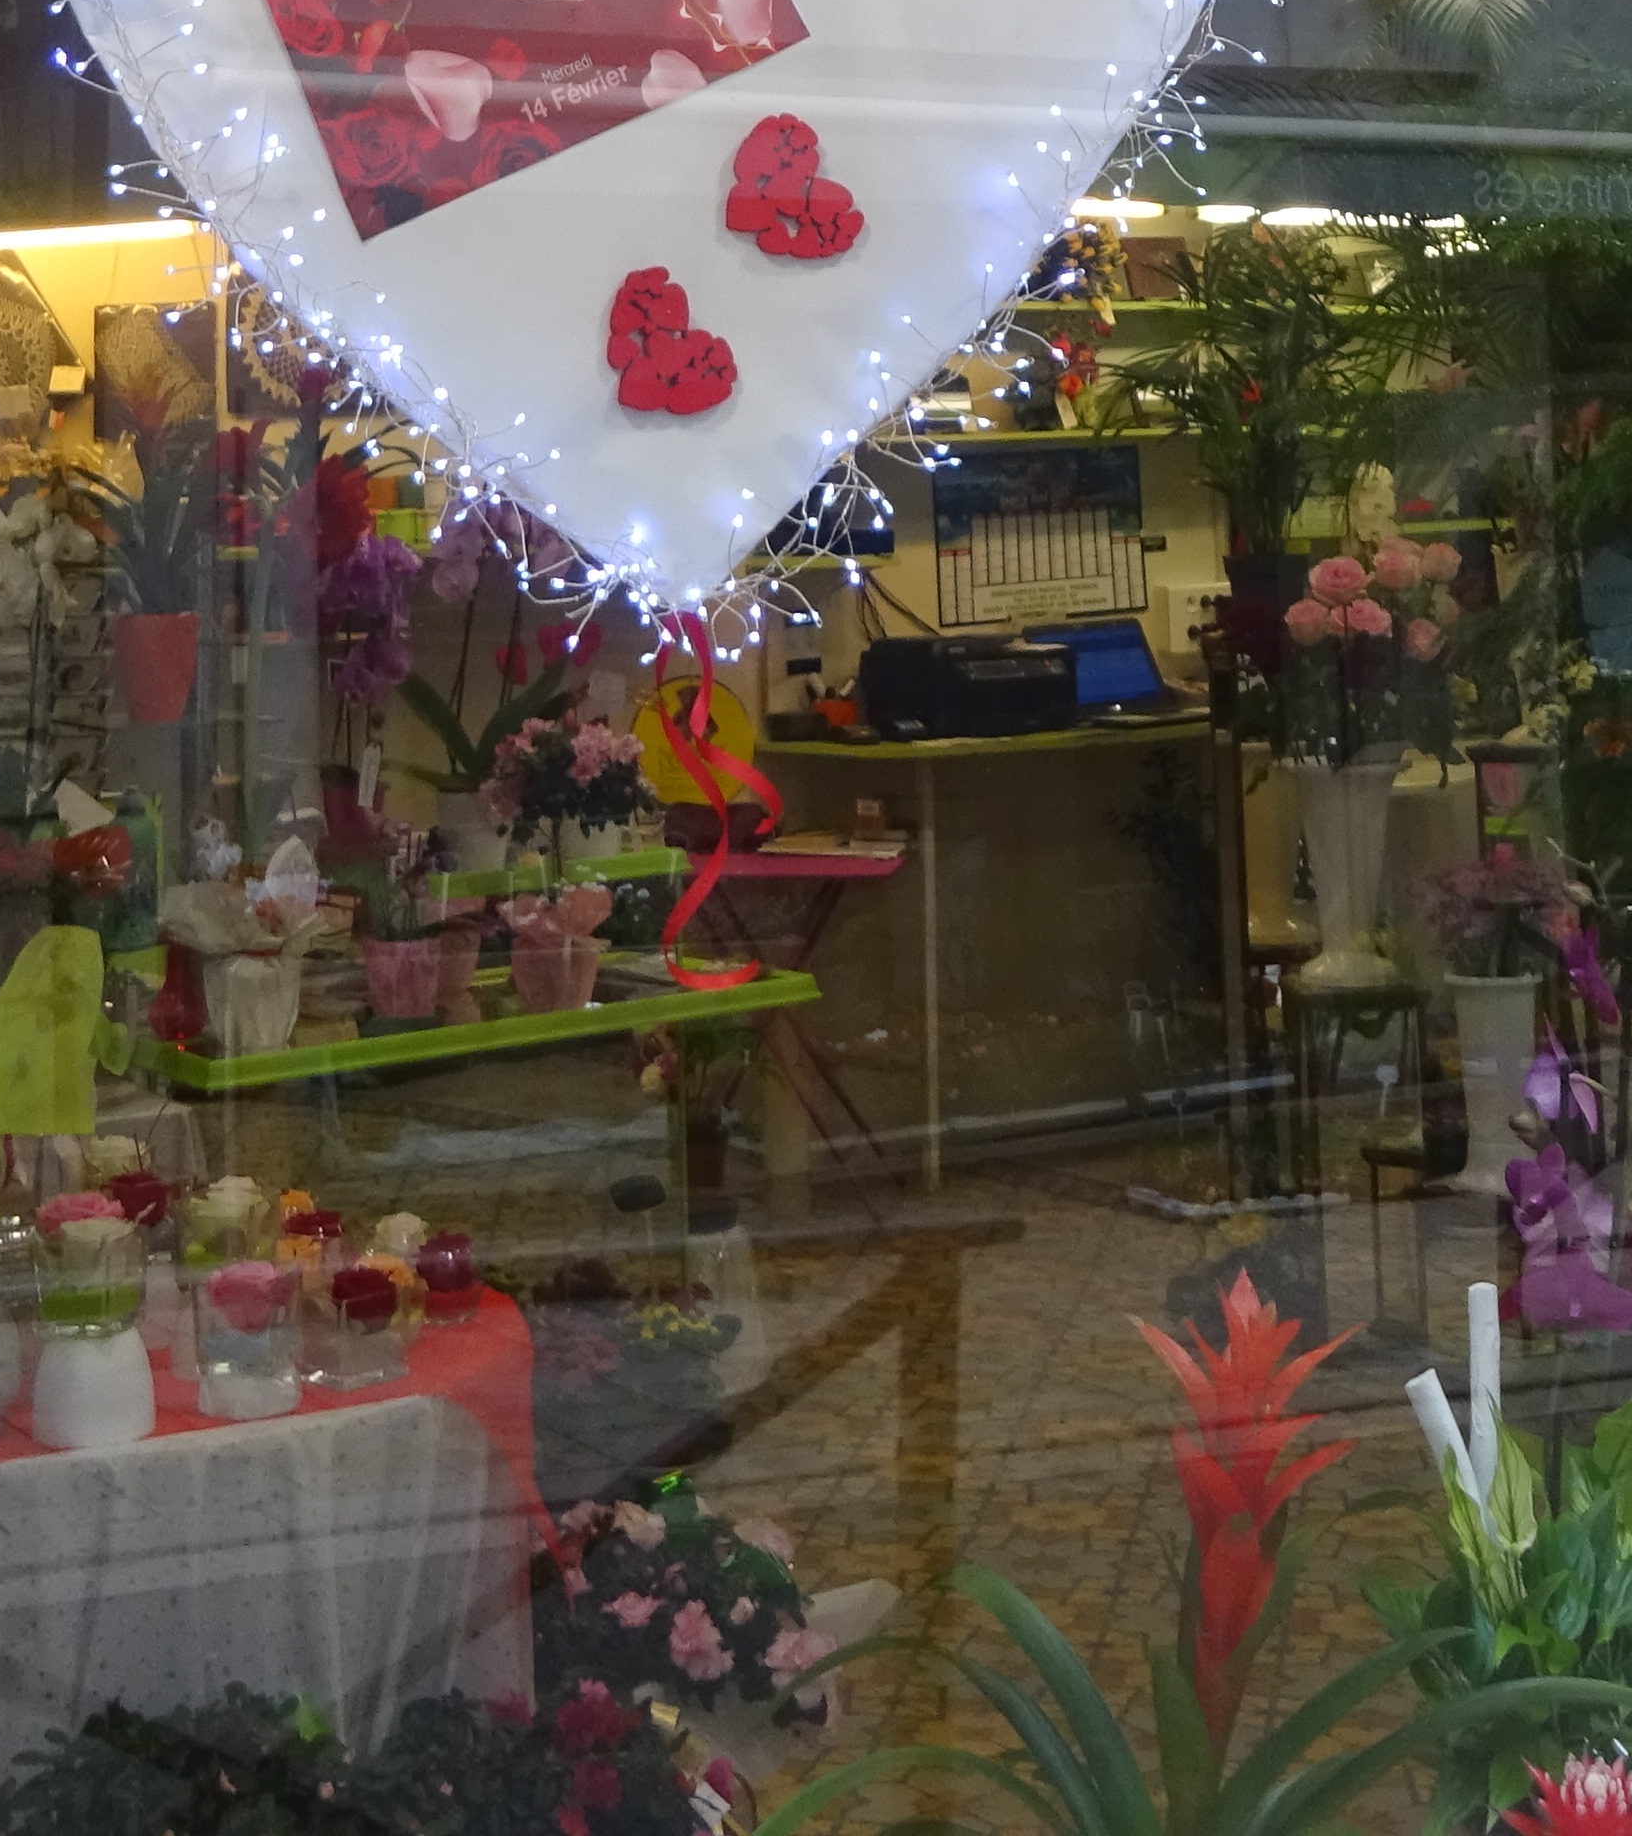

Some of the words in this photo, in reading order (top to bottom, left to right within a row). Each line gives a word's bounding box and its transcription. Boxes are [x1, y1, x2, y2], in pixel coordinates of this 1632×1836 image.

[541, 53, 593, 84] Mercredi
[520, 97, 547, 123] 14
[551, 65, 628, 111] Février
